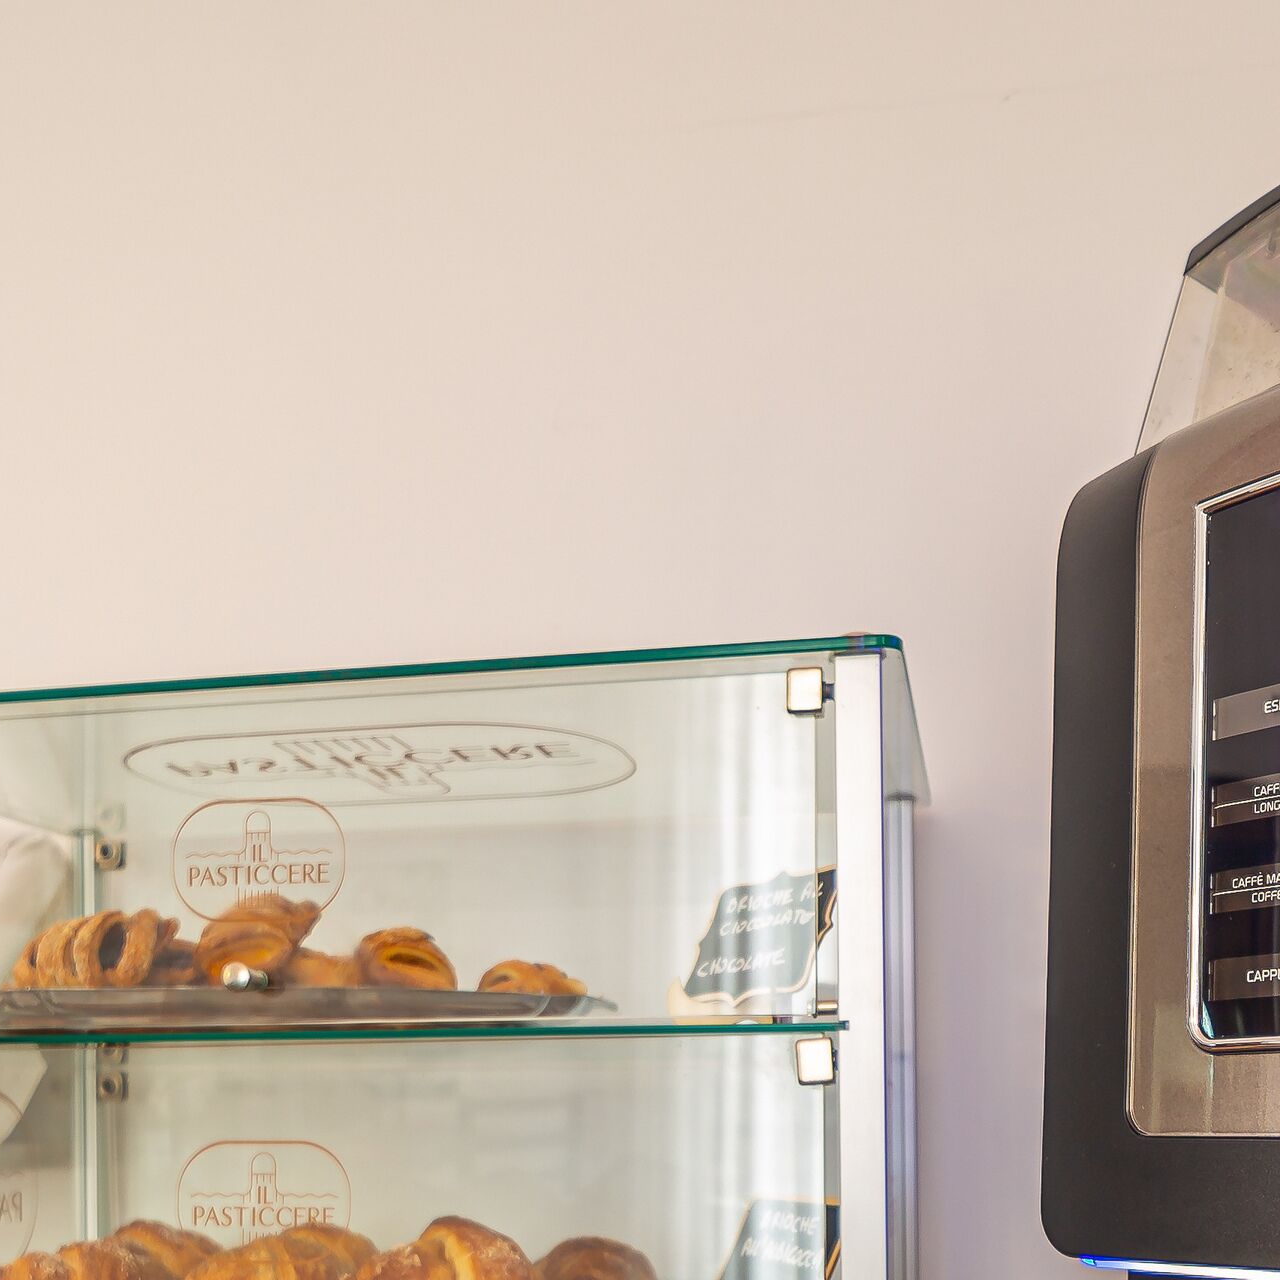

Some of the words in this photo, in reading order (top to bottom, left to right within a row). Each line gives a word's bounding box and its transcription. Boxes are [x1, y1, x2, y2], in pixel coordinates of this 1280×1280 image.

[1254, 800, 1280, 814] LONG
[251, 844, 268, 862] IL
[187, 862, 331, 887] PASTICCERE
[1232, 872, 1264, 889] CAFFÈ
[696, 948, 786, 978] CHOCOLATE
[257, 1185, 274, 1204] IL
[191, 1205, 336, 1228] PASTICCERE
